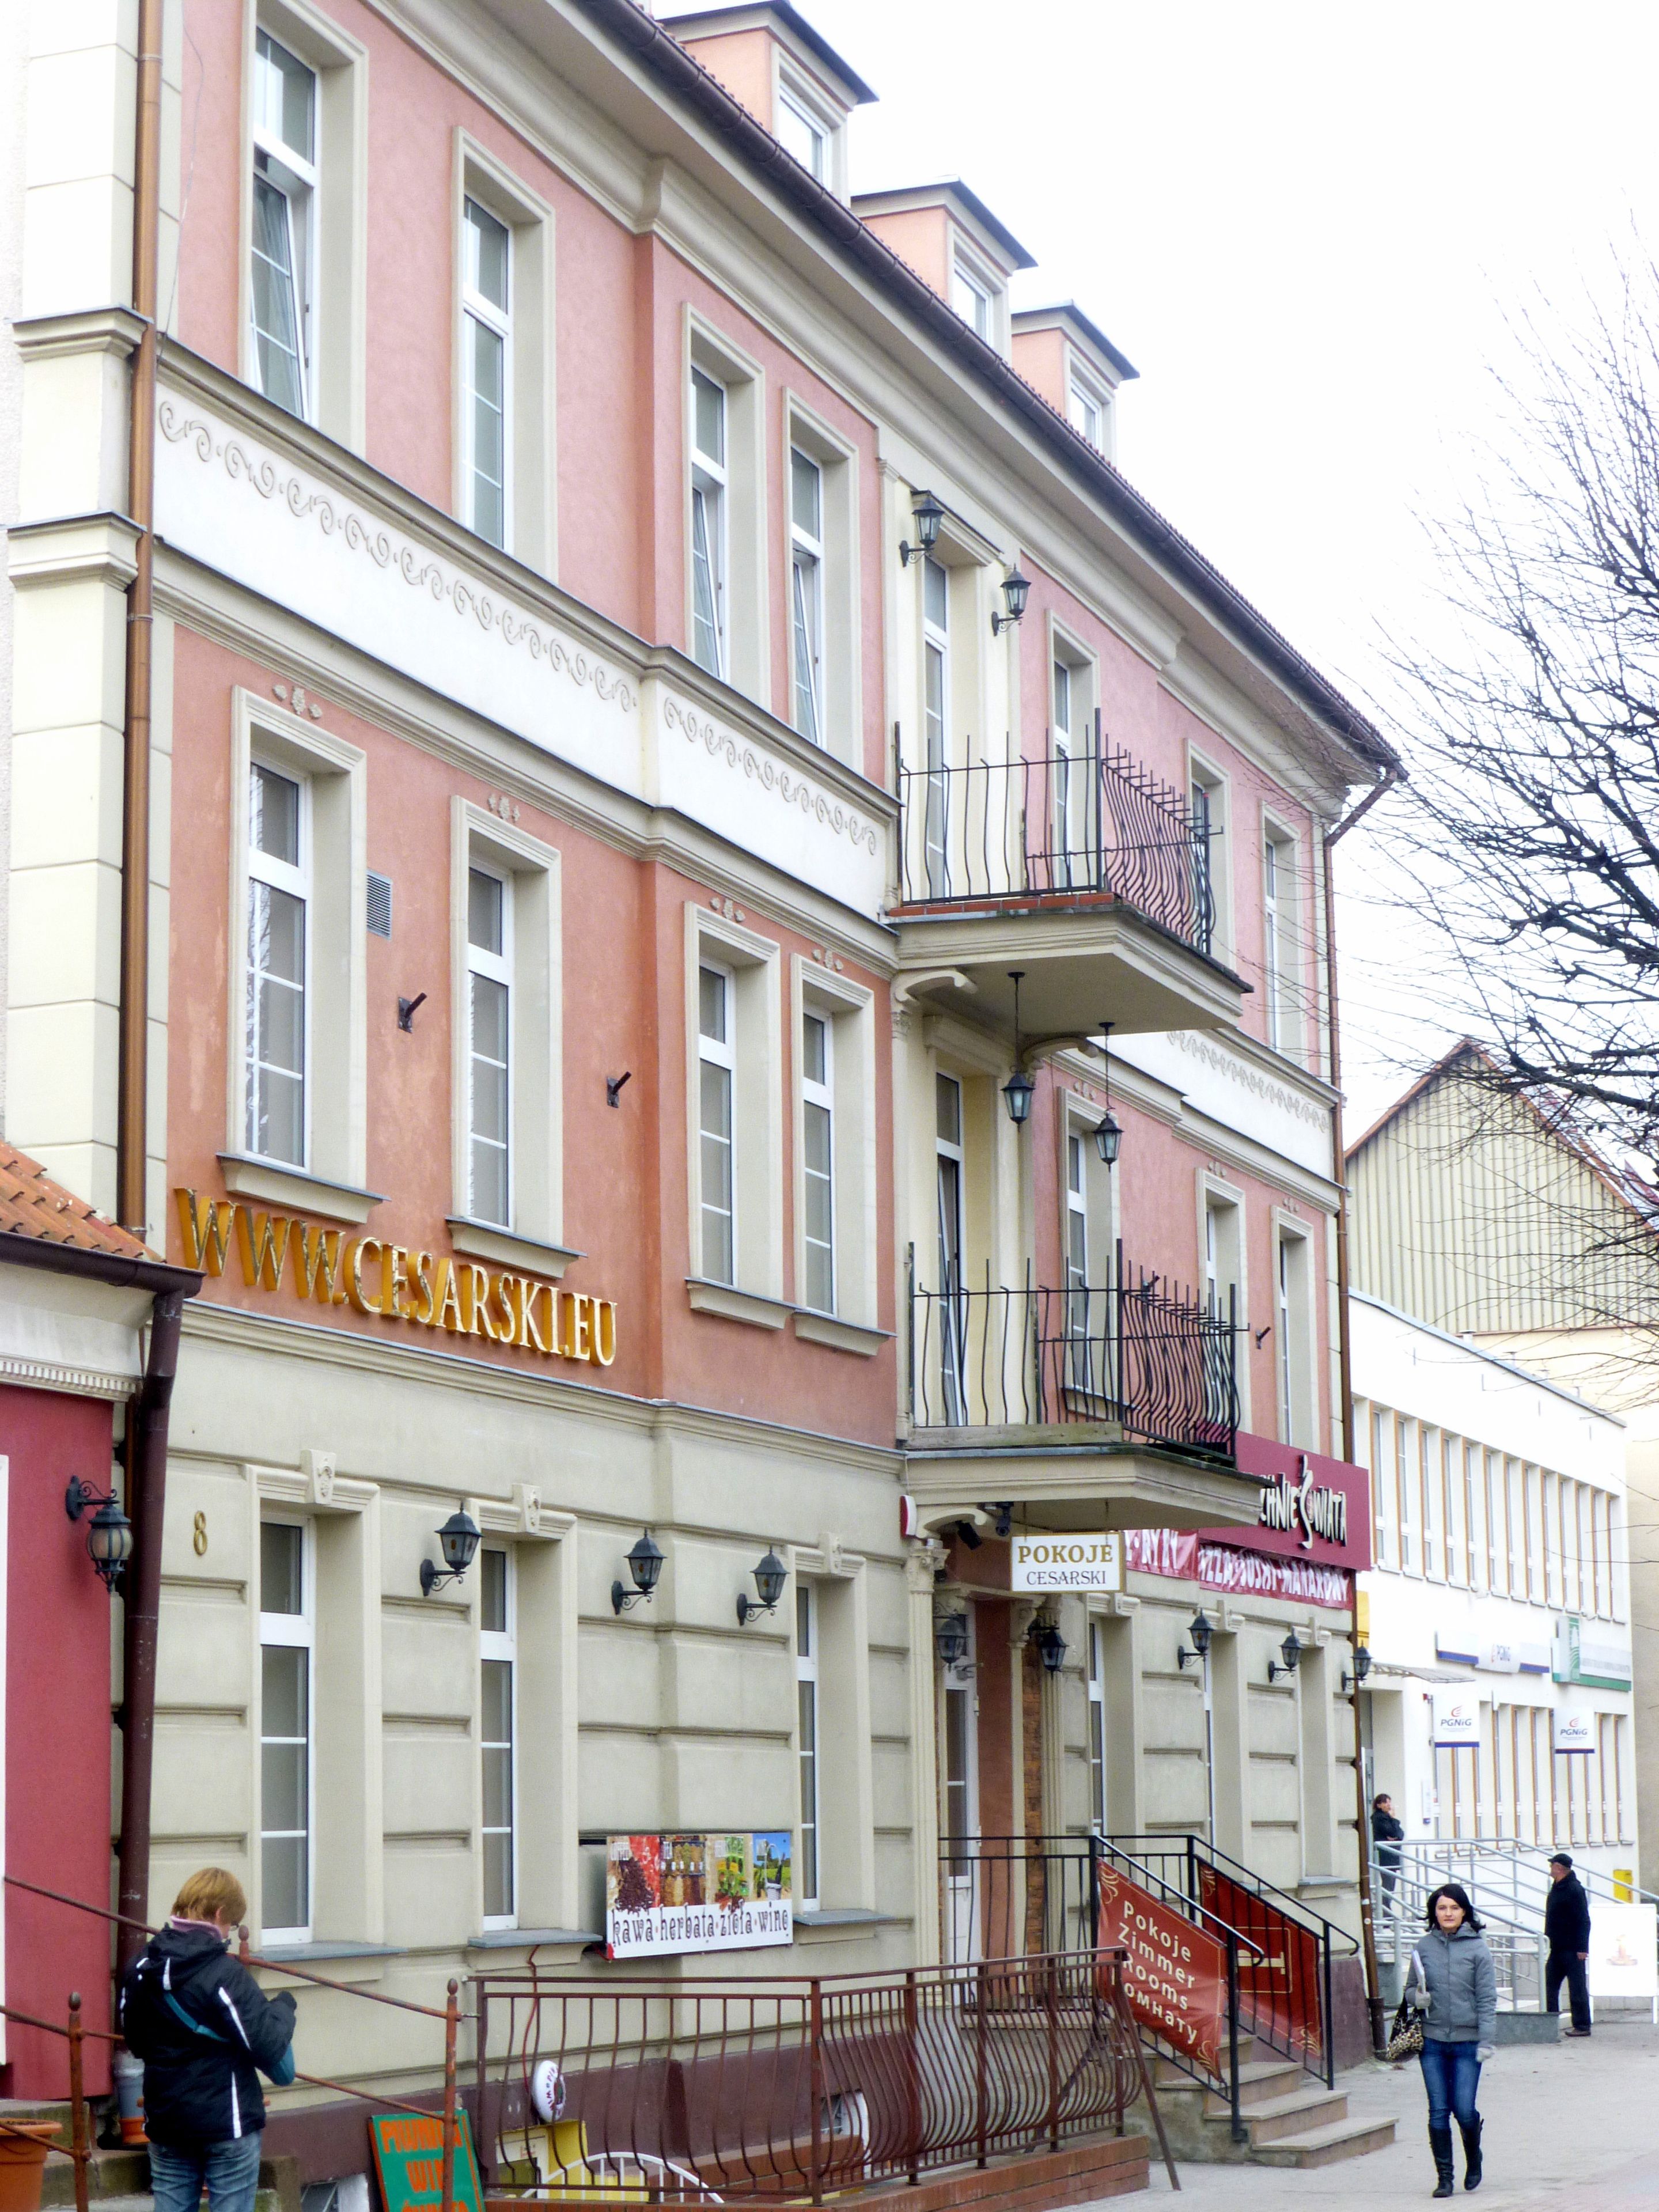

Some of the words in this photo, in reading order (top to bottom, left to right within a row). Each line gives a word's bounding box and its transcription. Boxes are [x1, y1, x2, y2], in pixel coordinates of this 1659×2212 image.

[175, 1187, 618, 1367] WWW.CESARSKI.EU
[194, 1510, 207, 1556] 8
[1018, 1545, 1113, 1563] POKOJE
[1027, 1571, 1106, 1585] CESARSKI
[1441, 1718, 1472, 1726] PGNiG
[612, 1908, 654, 1946] kawa
[660, 1902, 715, 1941] herbata
[1123, 1900, 1191, 1963] Pokoje
[1118, 1922, 1196, 1990] Zimmer
[1123, 1952, 1189, 2011] Rooms
[1111, 1967, 1198, 2045] омнату
